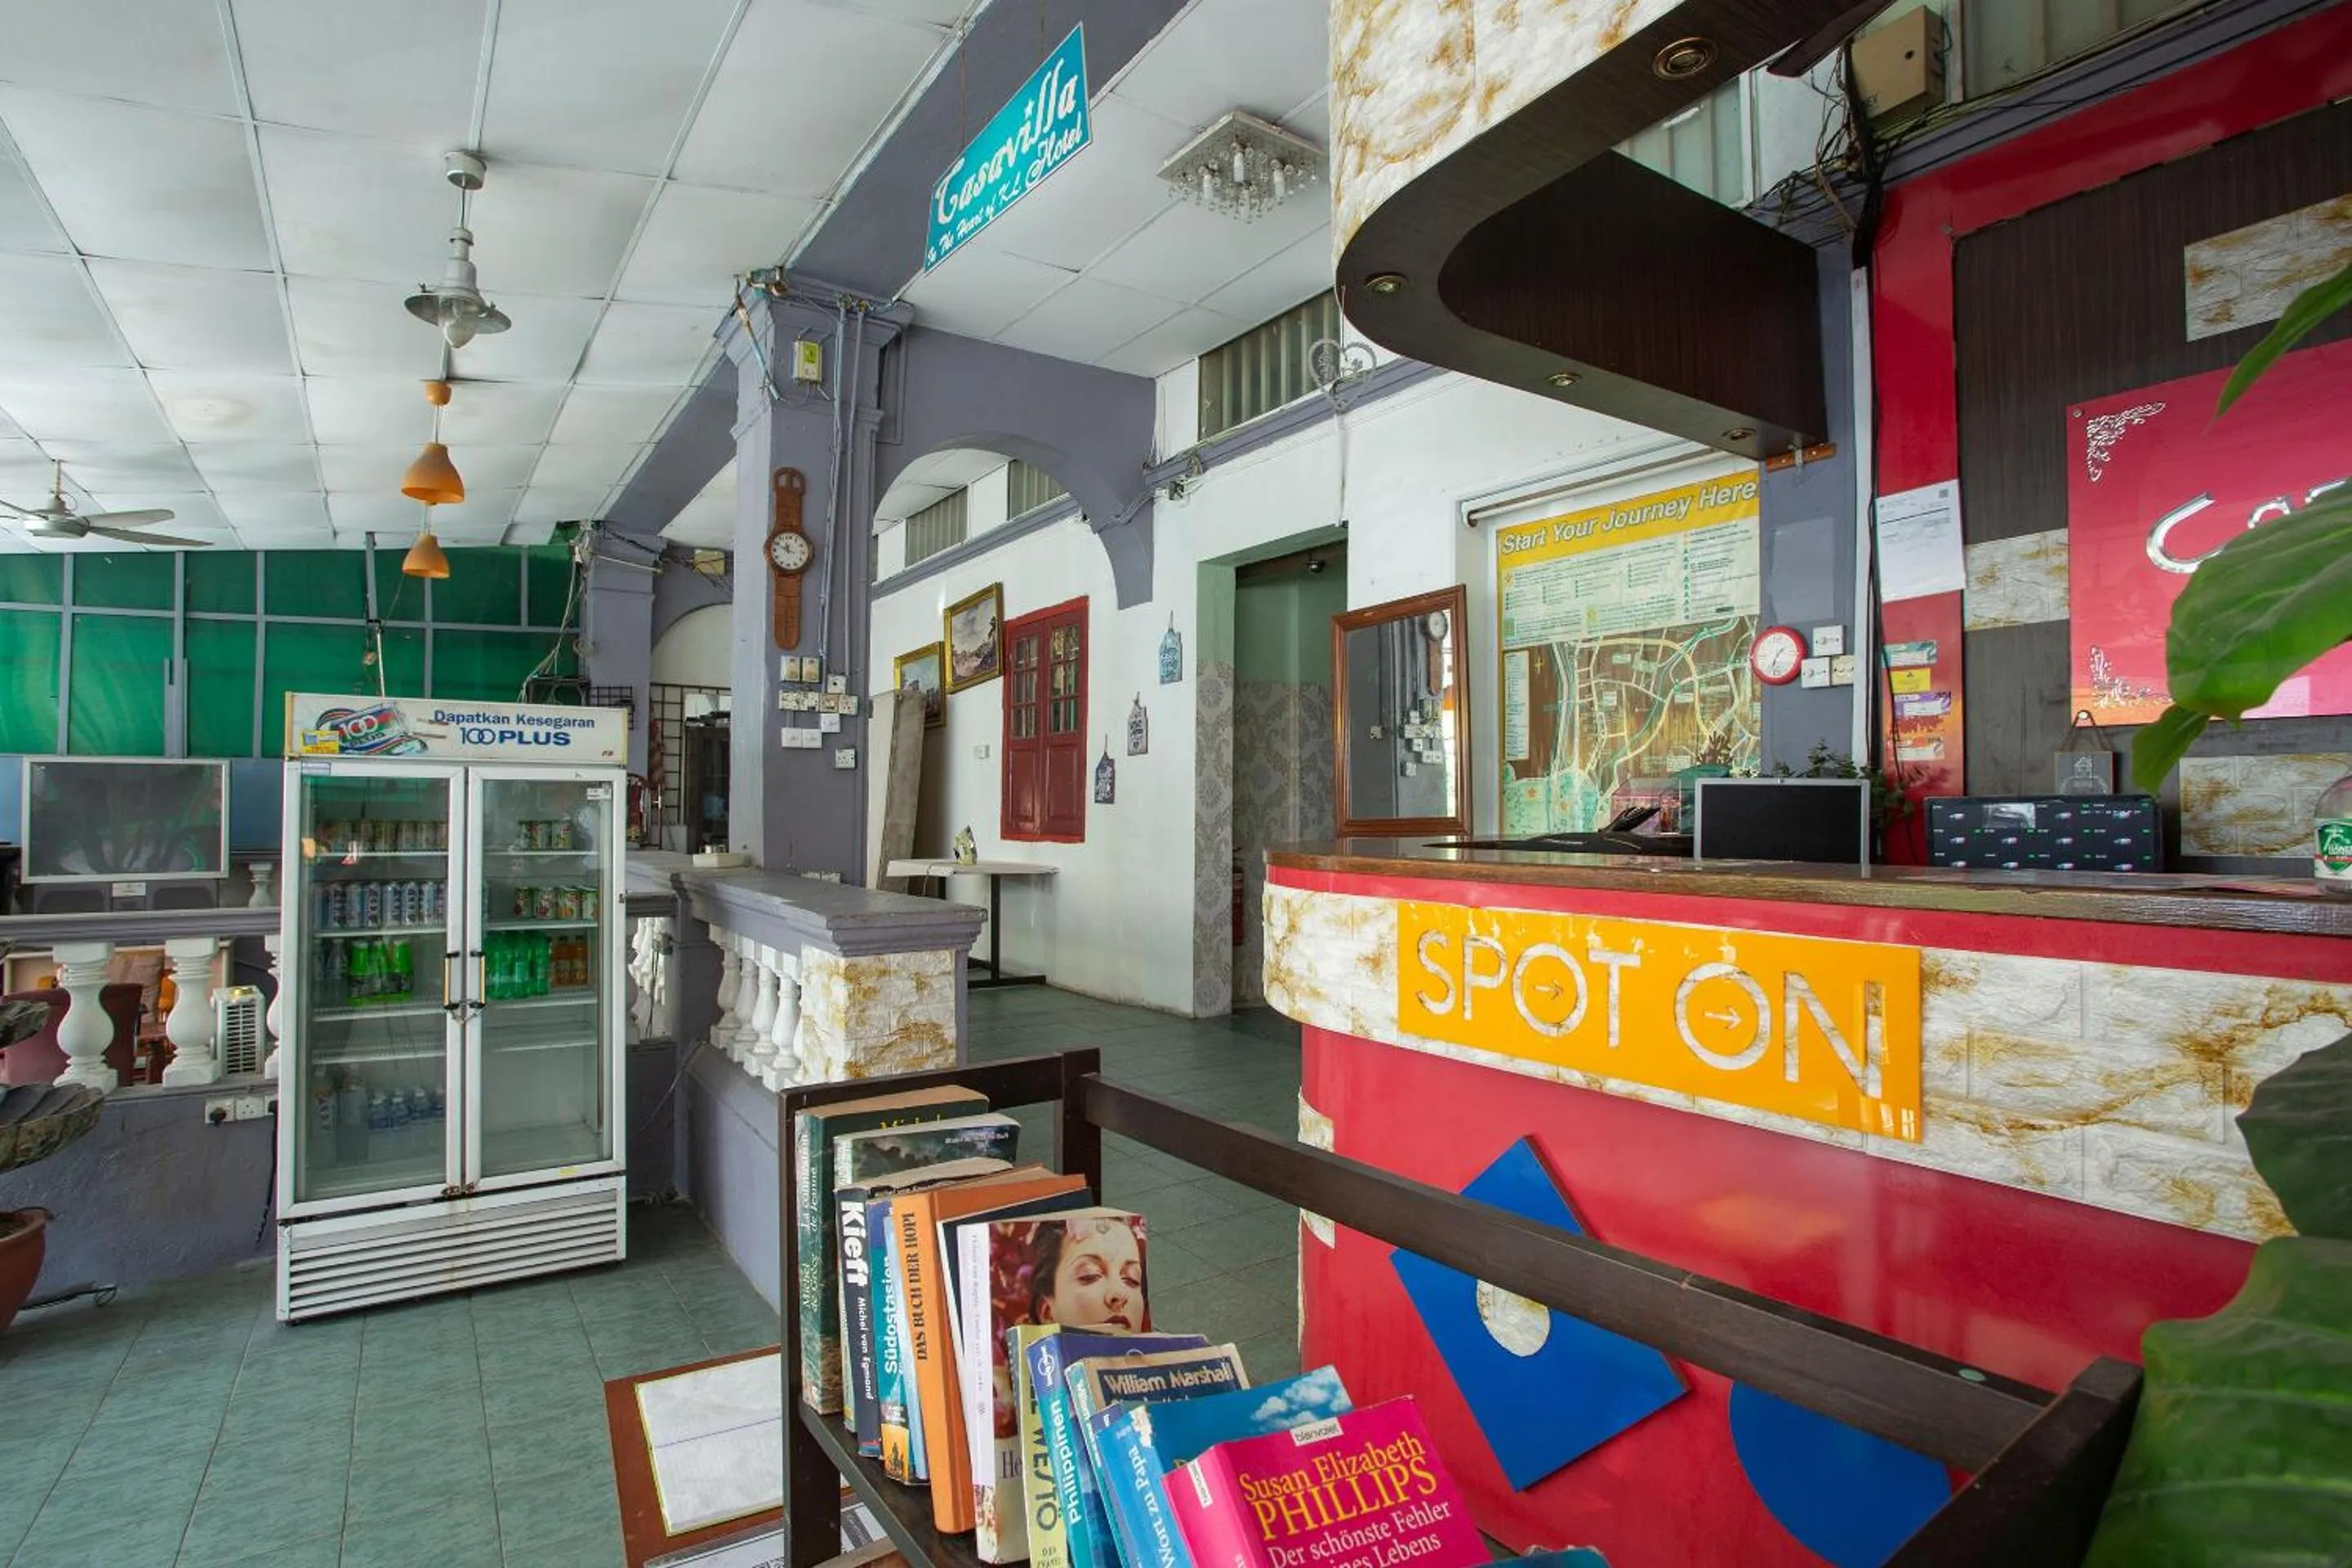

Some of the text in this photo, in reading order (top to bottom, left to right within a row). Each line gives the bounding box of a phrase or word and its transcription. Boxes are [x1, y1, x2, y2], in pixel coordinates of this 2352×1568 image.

[1501, 479, 1757, 555] Start Your Journey Here
[434, 709, 595, 729] Dapatkan Kesegaran
[1416, 928, 1884, 1100] SPOT ON
[840, 1200, 870, 1287] Kieft
[858, 1297, 868, 1330] Michel
[902, 1212, 928, 1361] DAS BUCH DER HOPI
[1103, 1361, 1234, 1395] William Marshall
[1051, 1400, 1081, 1526] Philippinen
[1239, 1471, 1314, 1502] Susan
[1312, 1430, 1426, 1482] Elizabeth
[1251, 1455, 1437, 1541] PHILLIPS
[1129, 1445, 1175, 1568] Wort zu Papa
[1267, 1546, 1307, 1568] Der
[1309, 1521, 1392, 1560] schönste
[1391, 1499, 1451, 1534] Fehler
[1373, 1532, 1442, 1567] Lebens
